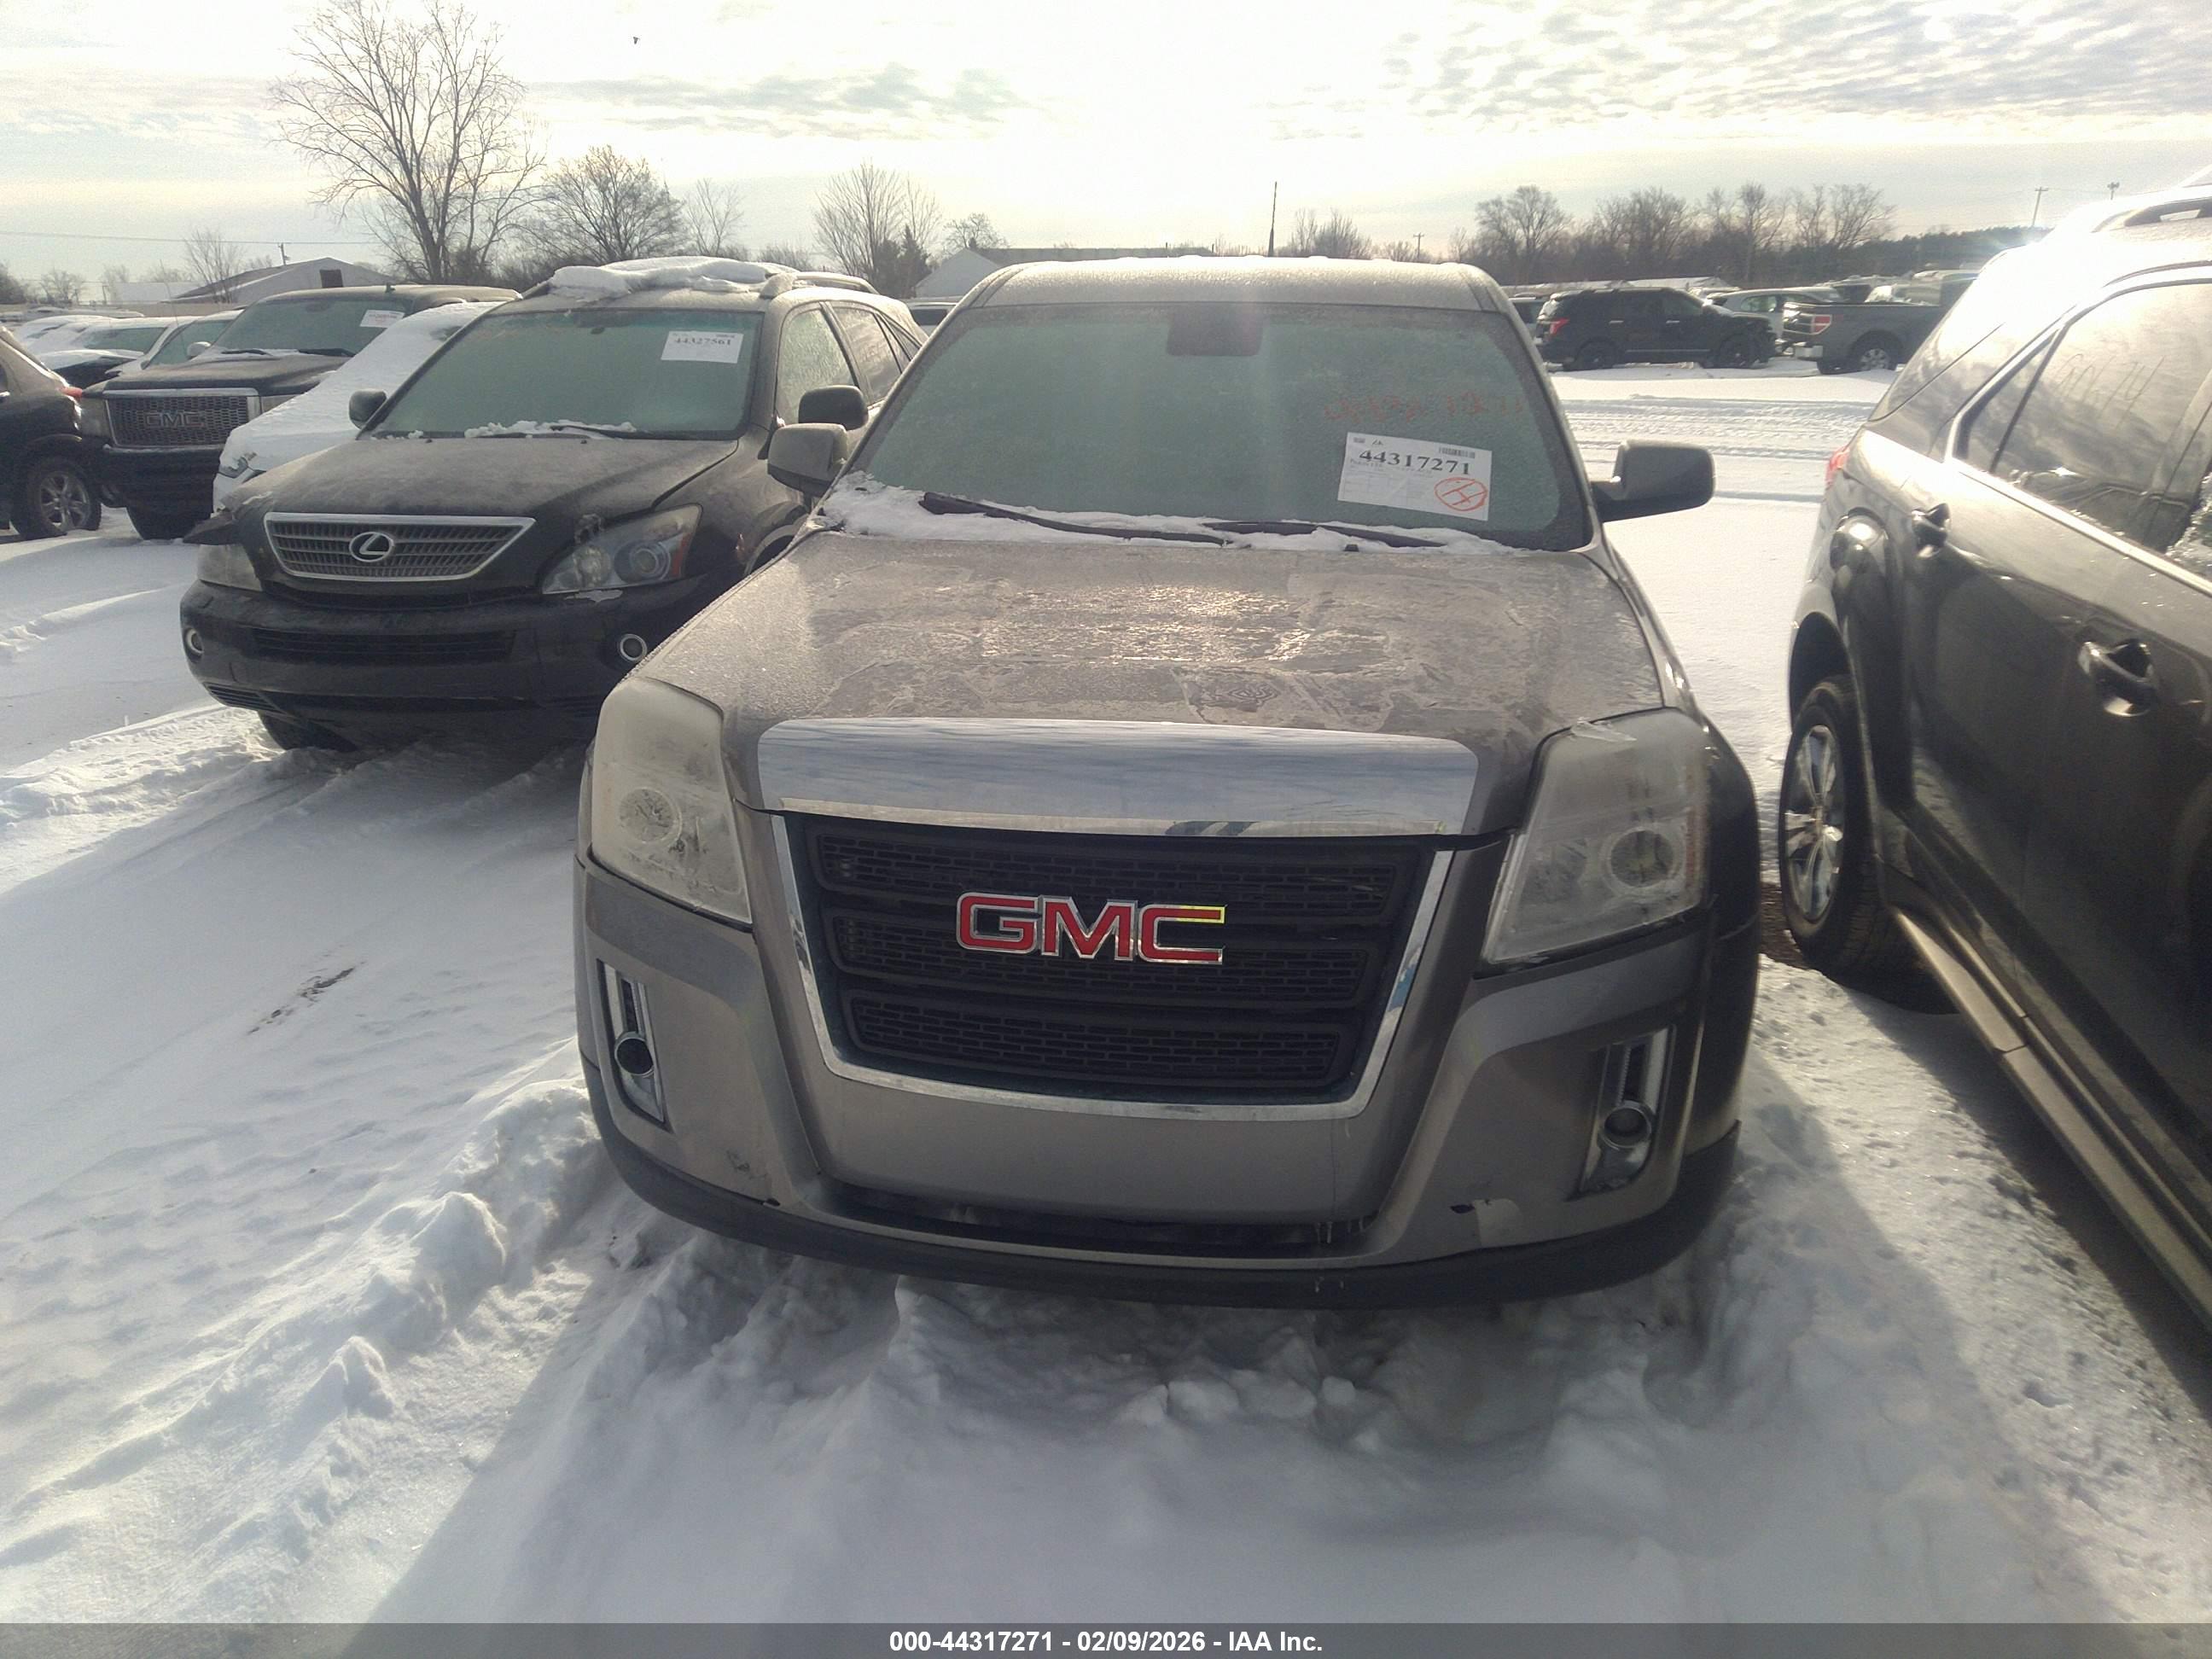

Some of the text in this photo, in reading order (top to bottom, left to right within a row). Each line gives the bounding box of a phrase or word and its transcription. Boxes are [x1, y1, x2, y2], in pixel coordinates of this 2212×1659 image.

[144, 410, 205, 427] GMC
[1359, 449, 1471, 475] 44317271
[956, 892, 1227, 965] GMC
